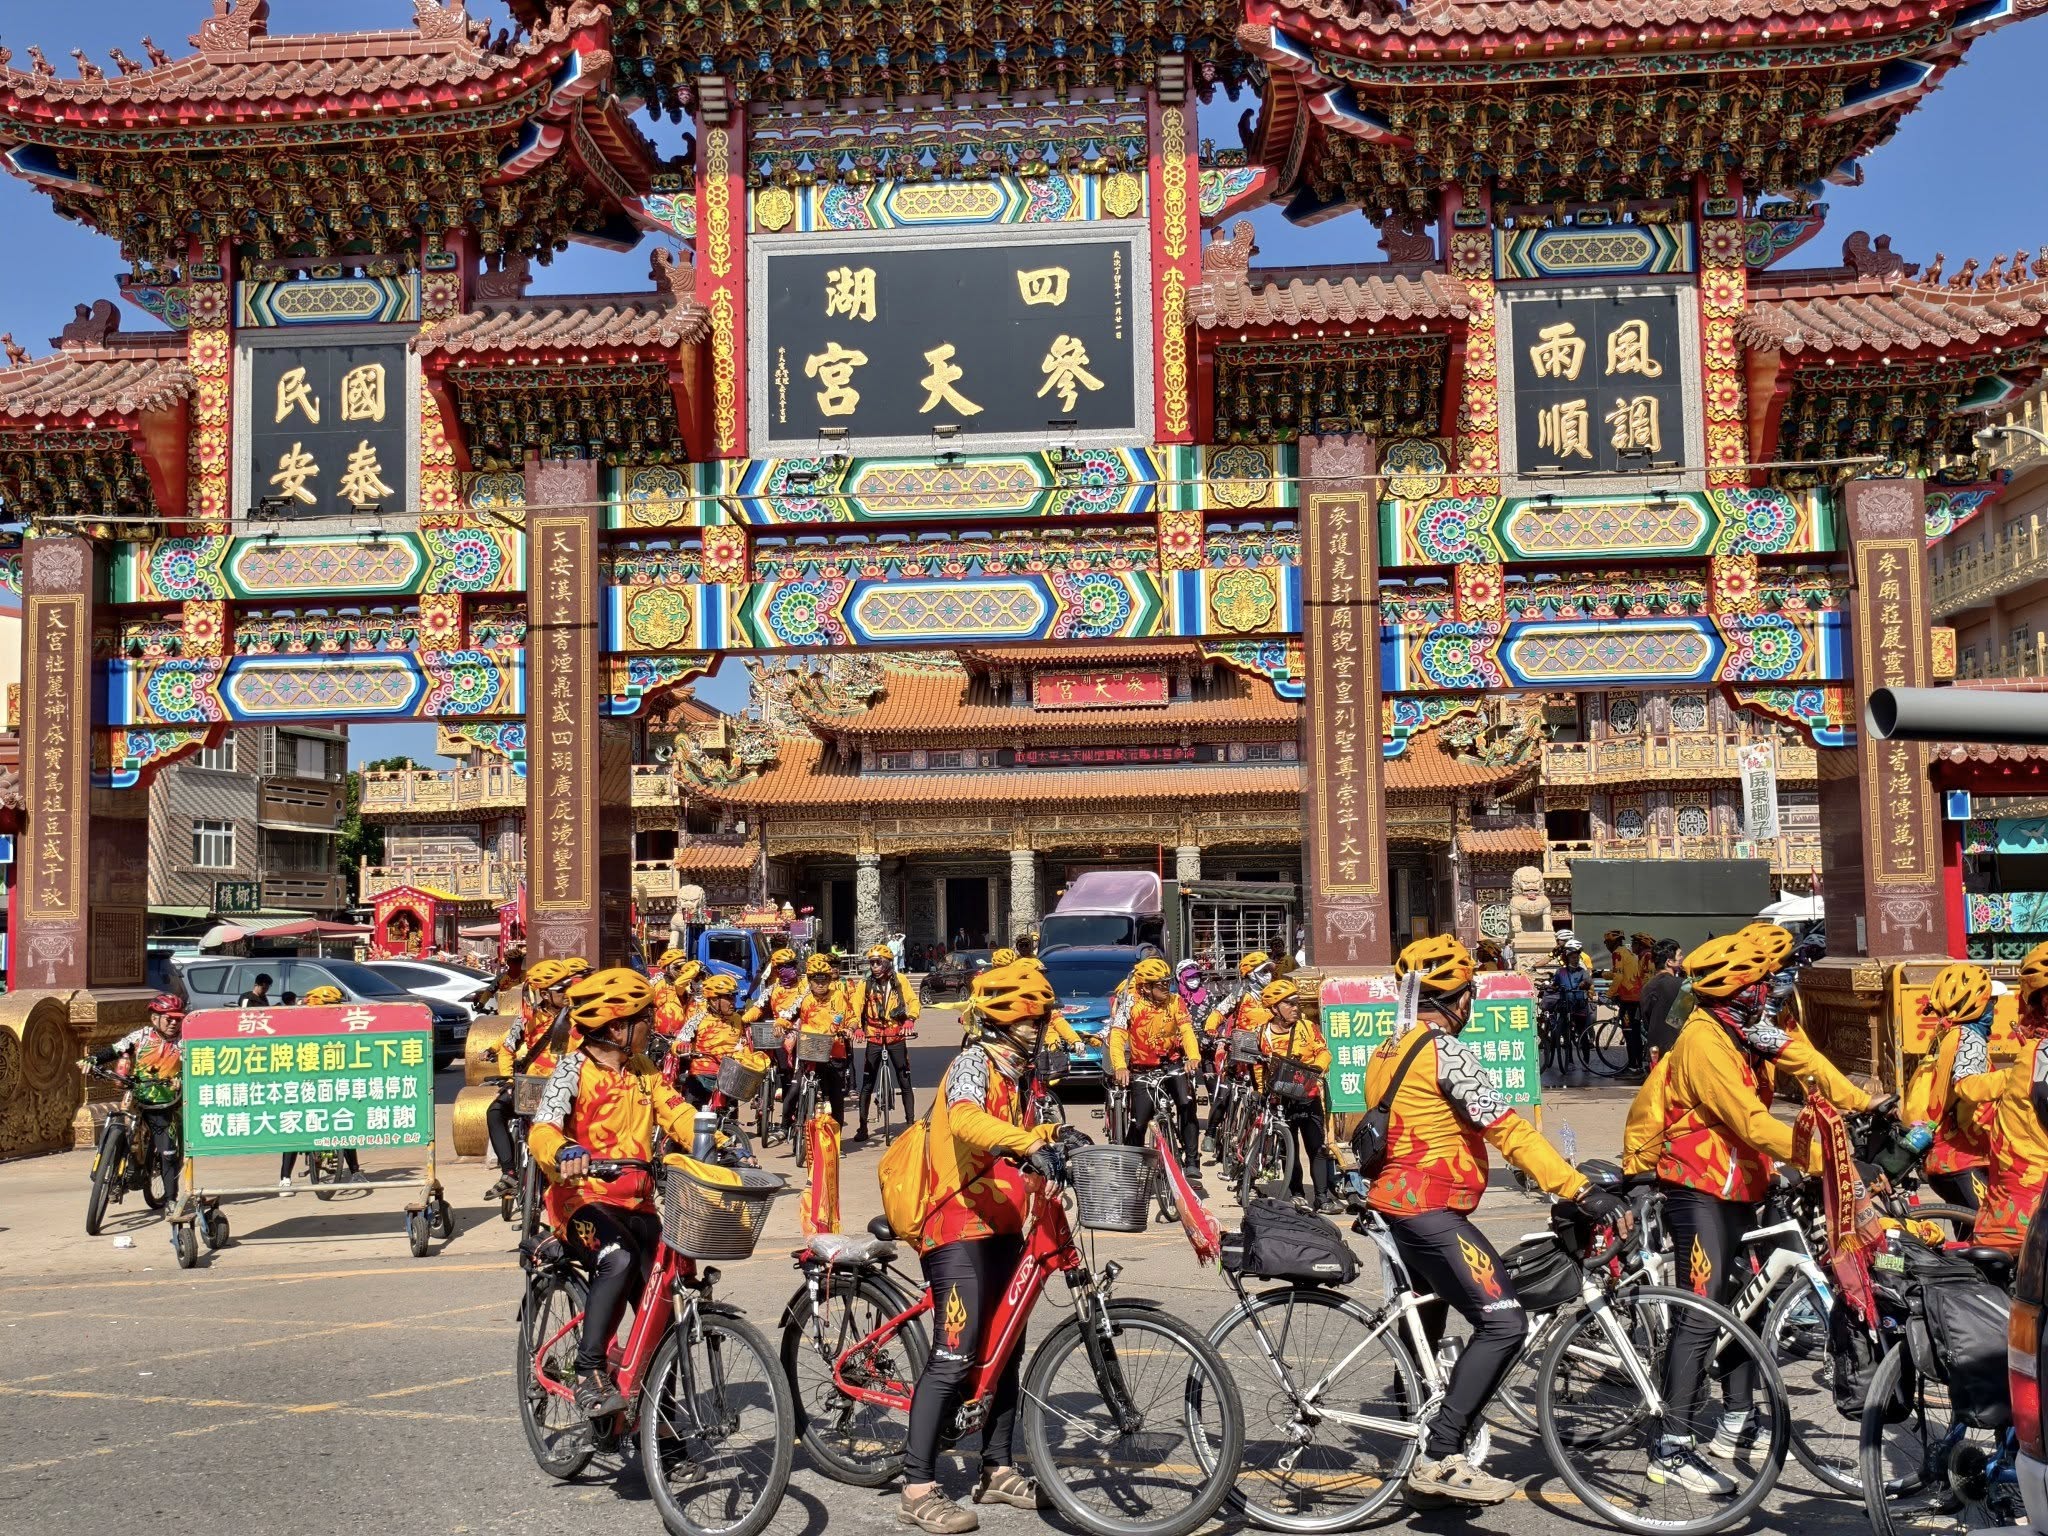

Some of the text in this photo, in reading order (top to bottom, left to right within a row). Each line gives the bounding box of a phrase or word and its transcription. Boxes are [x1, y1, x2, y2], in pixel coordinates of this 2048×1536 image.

[804, 334, 1105, 417] 參天宮
[1529, 322, 1594, 459] 雨順
[1605, 319, 1663, 453] 風調
[269, 366, 321, 504] 民安
[336, 363, 395, 504] 國泰
[1057, 676, 1146, 700] 參天宮
[1749, 770, 1771, 838] 屏東椰子
[238, 1009, 377, 1035] 敬告
[191, 1038, 425, 1077] 請勿在牌樓前上下車
[198, 1075, 418, 1108] 車輛請往本宮後面停車場停放
[200, 1104, 417, 1138] 敬請大家配合 謝謝
